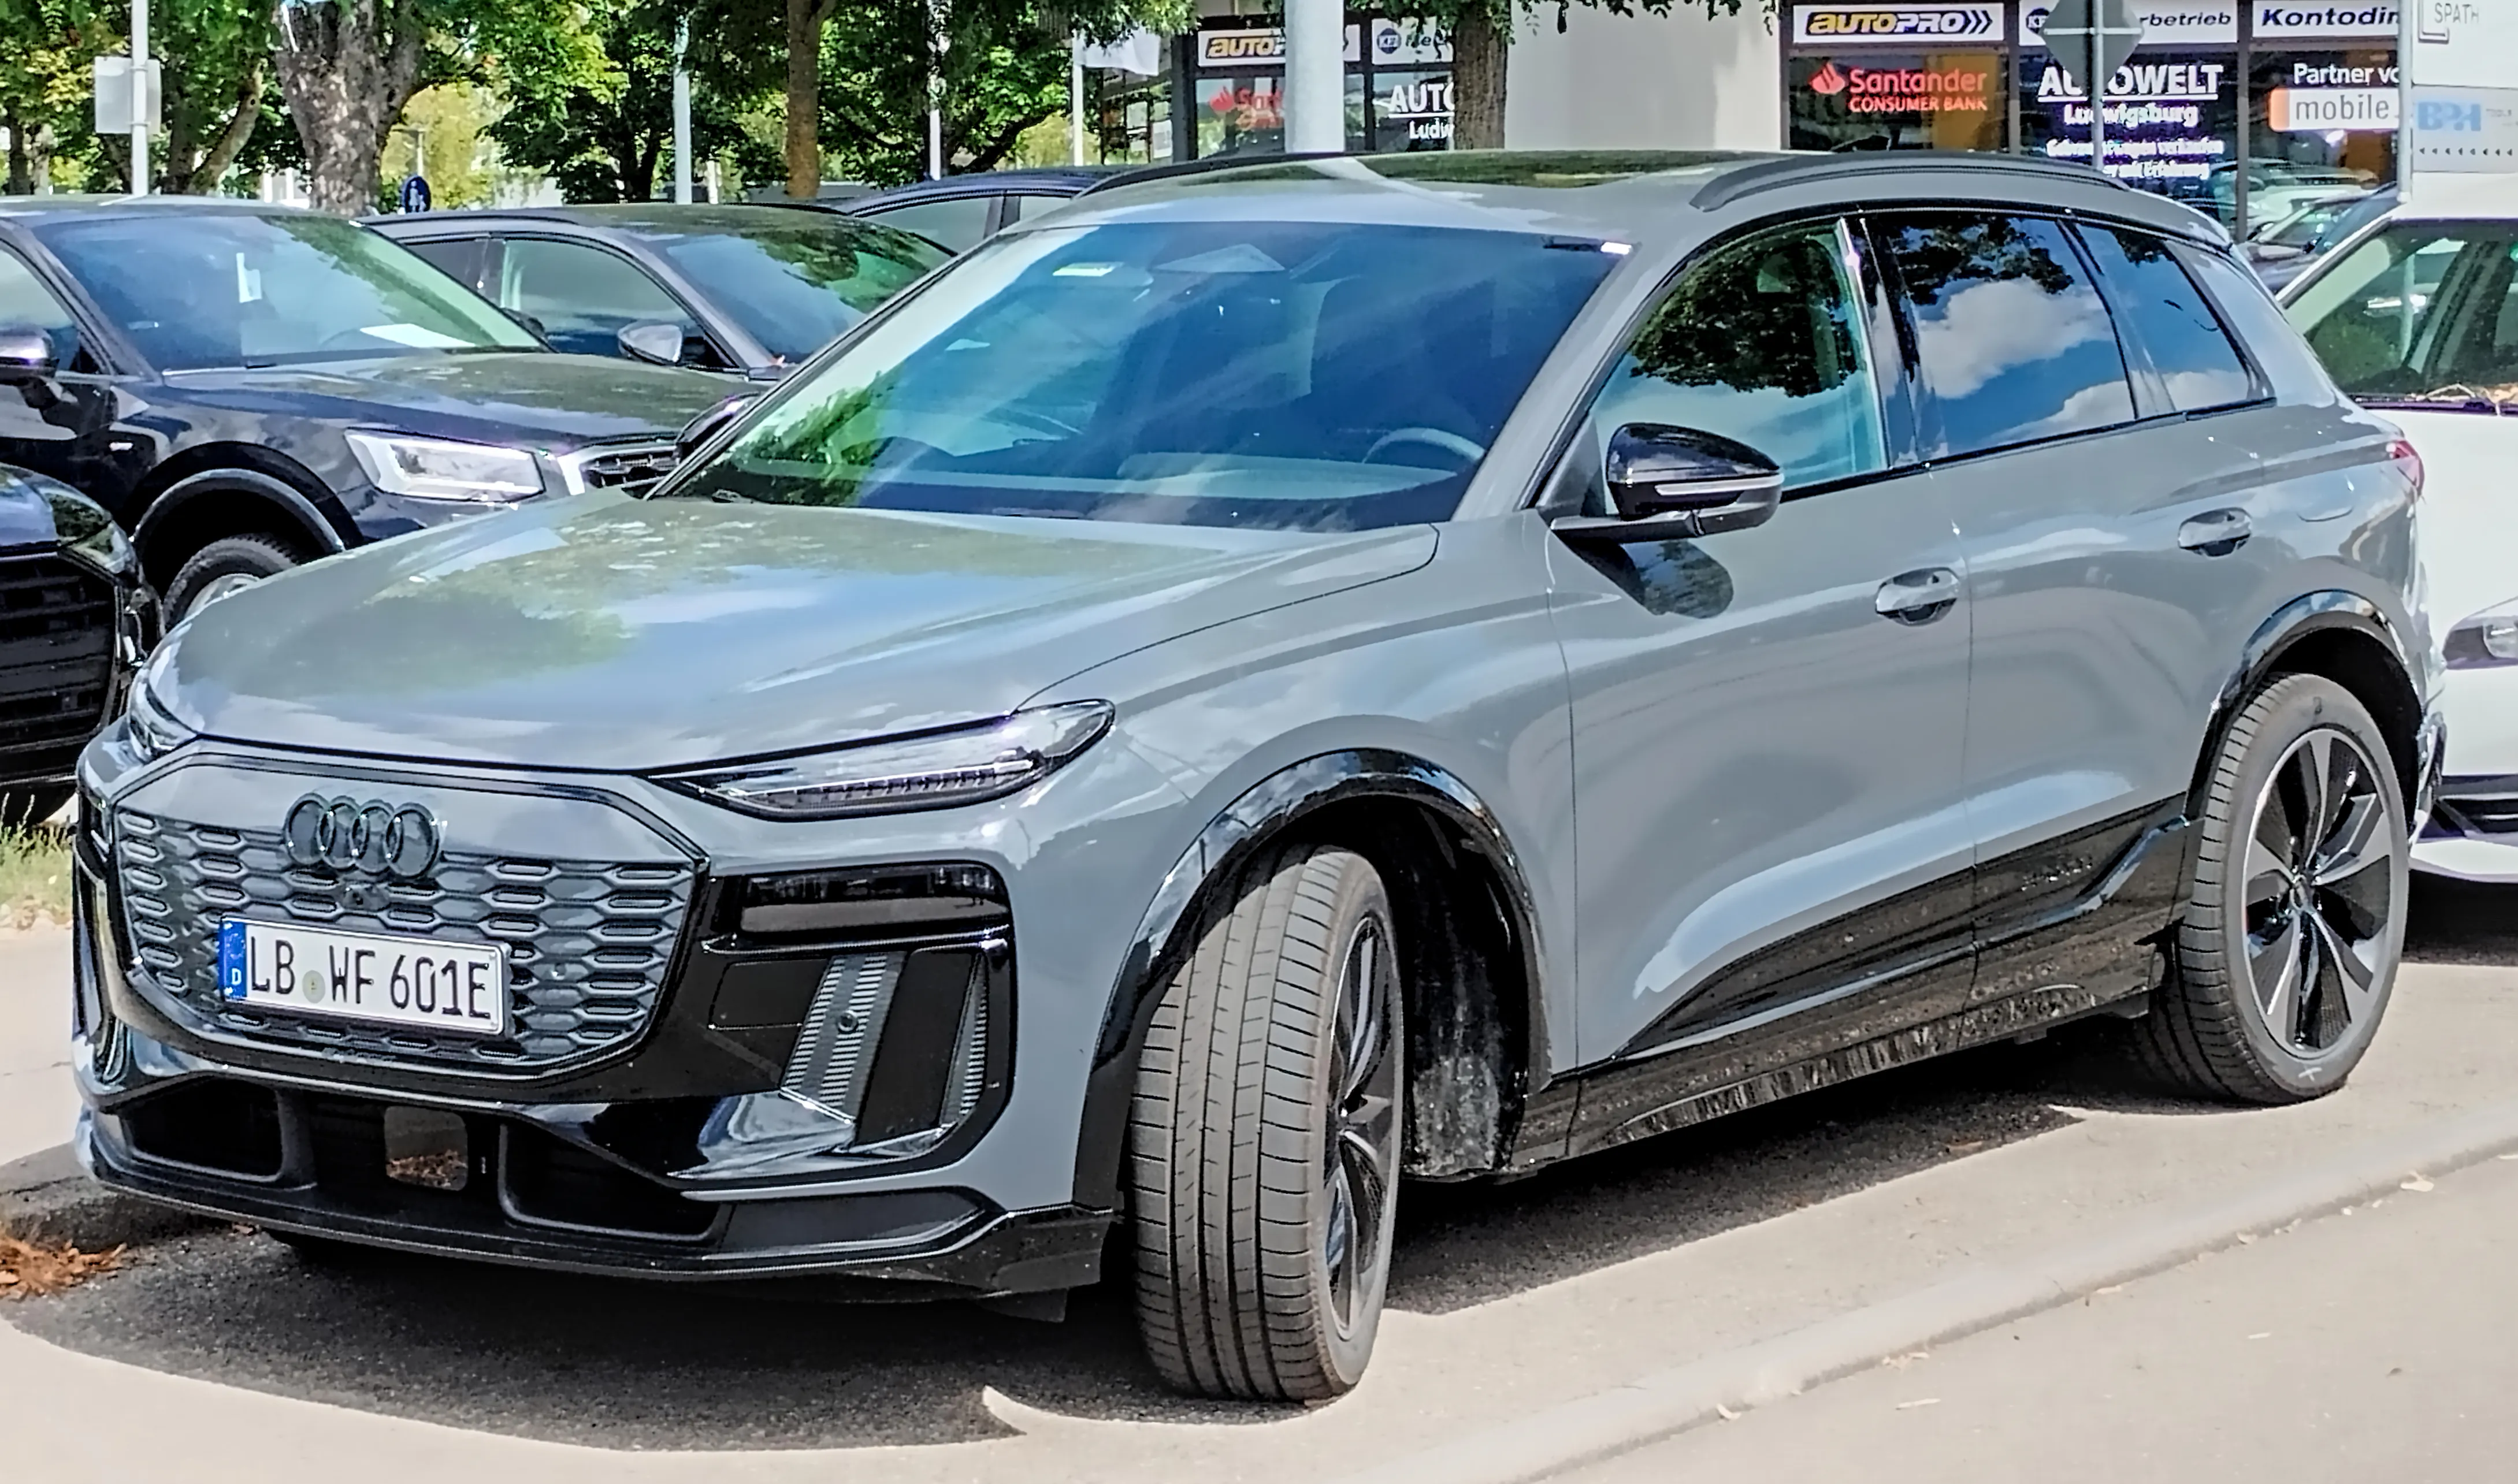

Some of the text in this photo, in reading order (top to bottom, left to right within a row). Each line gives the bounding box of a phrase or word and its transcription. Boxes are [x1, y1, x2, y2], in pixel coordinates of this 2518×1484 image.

[2261, 6, 2400, 27] Kontodin
[1849, 68, 1988, 93] Santander
[2038, 65, 2223, 95] AUOWELT
[2293, 64, 2374, 85] Partner
[1849, 96, 1988, 113] CONSUMER BANK
[232, 968, 242, 985] D
[250, 936, 491, 1020] LB WF 601E
